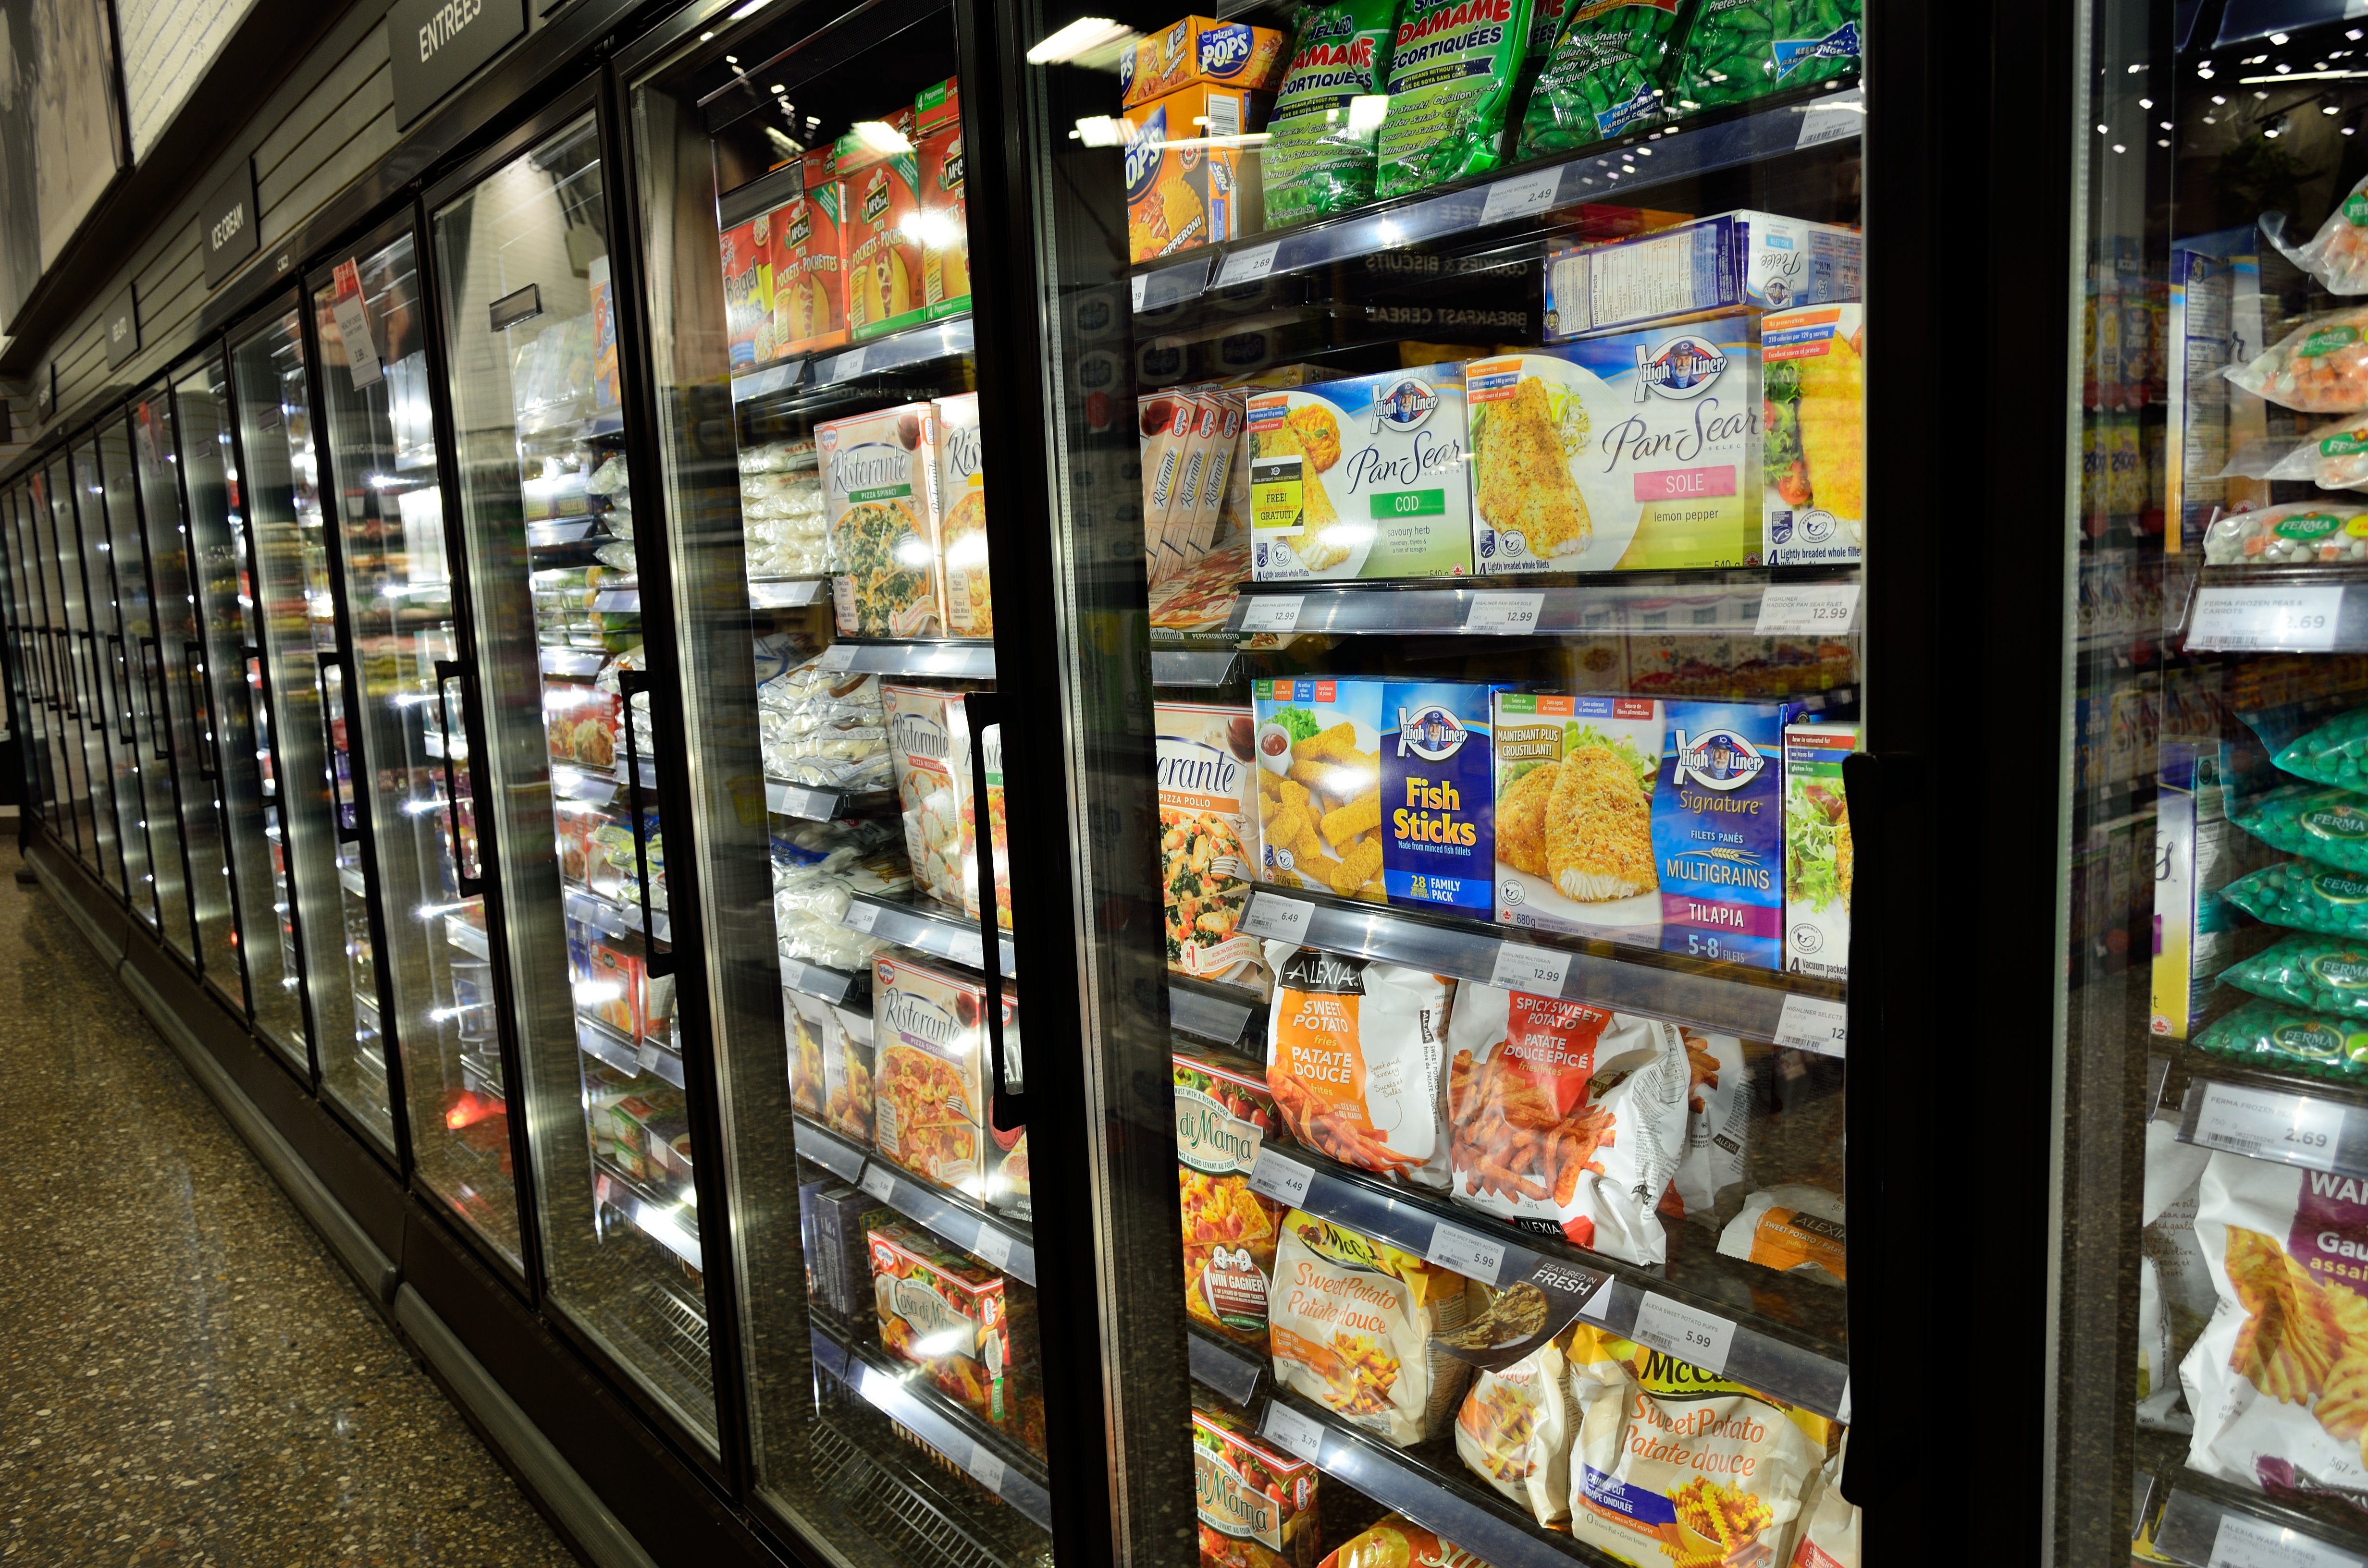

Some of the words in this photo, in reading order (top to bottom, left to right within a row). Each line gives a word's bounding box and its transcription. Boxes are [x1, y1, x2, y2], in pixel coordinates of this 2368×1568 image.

[419, 0, 482, 63] ENTREES
[1213, 28, 1233, 43] pizza
[1200, 33, 1248, 74] POPS
[1162, 49, 1186, 82] PEPPERONI
[1551, 61, 1578, 75] Ready
[1403, 70, 1428, 83] SOYBEANS
[1430, 65, 1454, 75] WITHOUT
[1612, 107, 1628, 118] KEEP
[1602, 115, 1629, 131] GARDER
[1491, 189, 1513, 197] EDAMAME
[1514, 183, 1538, 191] SOYBEANS
[1528, 189, 1552, 202] 2.49
[867, 194, 888, 217] McCain
[873, 219, 885, 233] PIZZA
[796, 247, 806, 257] PIZZA
[852, 237, 877, 268] POCKETS
[777, 262, 799, 289] POCKETS
[802, 254, 837, 272] POCHETTES
[1253, 258, 1270, 269] 2.69
[725, 256, 758, 303] Bagel
[934, 301, 952, 314] Pepperoni
[1776, 317, 1804, 327] preservatives
[1814, 330, 1828, 339] serving
[1805, 347, 1820, 355] protein
[1641, 361, 1670, 385] High
[1692, 355, 1725, 375] Liner
[1376, 397, 1397, 417] High
[1413, 395, 1436, 412] Liner
[1602, 397, 1759, 474] Pan-Sear
[827, 445, 906, 493] Ristorante
[1347, 431, 1463, 494] Pan-Sear
[1666, 474, 1704, 493] SOLE
[877, 489, 897, 498] SPINACI
[1266, 493, 1287, 503] FREE!
[1395, 496, 1419, 512] COD
[1261, 510, 1295, 520] GRATUIT!
[1654, 510, 1681, 523] lemon
[1686, 510, 1719, 523] pepper
[1387, 527, 1412, 537] savoury
[1414, 526, 1430, 536] herb
[2280, 520, 2331, 534] FERMA
[1801, 548, 1825, 559] breaded
[1827, 547, 1846, 558] whole
[1275, 612, 1294, 621] 12.99
[1507, 612, 1532, 621] 12.99
[1813, 608, 1847, 618] 12.99
[892, 712, 949, 759] Ristorante
[1403, 724, 1424, 741] High
[1441, 724, 1465, 743] Liner
[1498, 730, 1540, 742] MAINTENANT
[1541, 729, 1558, 742] PLUS
[1503, 745, 1552, 757] CROUSTILLANT!
[1681, 748, 1709, 769] High
[1729, 750, 1762, 771] Liner
[1159, 794, 1182, 805] PIZZA
[1184, 796, 1211, 808] POLLO
[1406, 777, 1460, 810] Fish
[1679, 790, 1759, 815] Signature
[1394, 808, 1476, 846] Sticks
[2312, 812, 2366, 831] FERMA
[1690, 829, 1716, 840] FILETS
[1718, 831, 1743, 844] PANÉS
[1398, 840, 1411, 849] Made
[1412, 842, 1423, 850] from
[1425, 844, 1443, 853] minced
[1444, 845, 1454, 855] fish
[1455, 846, 1471, 856] fillets
[1411, 875, 1426, 887] 28
[1666, 859, 1770, 890] MULTIGRAINS
[1431, 878, 1460, 892] FAMILY
[1432, 890, 1453, 903] PACK
[863, 915, 873, 923] 5.99
[1281, 912, 1298, 922] 6.49
[1689, 903, 1745, 928] TILAPIA
[1688, 935, 1719, 958] 5-8
[1723, 949, 1745, 964] FILETS
[1524, 956, 1551, 964] MULTIGRAIN
[1285, 959, 1356, 985] ALEXIA
[1534, 969, 1559, 981] 12.99
[1826, 964, 1847, 975] packed
[1303, 1000, 1341, 1017] SWEET
[1517, 997, 1552, 1012] SPICY
[1550, 1001, 1603, 1023] SWEET
[1787, 1005, 1815, 1017] HIGHLINER
[1815, 1012, 1843, 1020] SELECTS
[883, 987, 960, 1048] Ristorante
[1293, 1016, 1348, 1033] POTATO
[1528, 1013, 1577, 1029] POTATO
[910, 1037, 925, 1048] PIZZA
[1314, 1035, 1337, 1047] fries
[1525, 1034, 1566, 1050] PATATE
[2284, 1029, 2334, 1048] FERMA
[1292, 1046, 1352, 1068] PATATE
[1504, 1045, 1544, 1061] DOUCE
[1293, 1062, 1351, 1084] DOUCE
[1310, 1083, 1333, 1096] frites
[2210, 1095, 2238, 1108] FERMA
[2240, 1101, 2274, 1116] FROZEN
[2284, 1127, 2328, 1148] 2.69
[879, 1181, 888, 1191] 5.99
[1285, 1179, 1303, 1191] 4.49
[1764, 1221, 1789, 1235] SWEET
[1788, 1229, 1816, 1244] POTATO
[1474, 1254, 1494, 1267] 5.99
[1542, 1262, 1586, 1281] FEATURED
[1586, 1276, 1597, 1284] IN
[1210, 1273, 1227, 1287] WIN
[1229, 1275, 1264, 1293] GAGNER
[1532, 1269, 1591, 1296] FRESH
[893, 1280, 918, 1316] Casa
[1645, 1302, 1663, 1311] ALEXIA
[1663, 1308, 1681, 1318] SWEET
[1702, 1323, 1718, 1333] PUFFS
[1685, 1330, 1711, 1348] 5.99
[1629, 1393, 1697, 1436] Sweet
[1698, 1409, 1765, 1444] Potato
[1301, 1434, 1317, 1448] 3.79
[1622, 1424, 1691, 1466] Patate
[1691, 1450, 1756, 1477] douce
[1586, 1472, 1611, 1490] CRINKLE
[1612, 1482, 1626, 1496] CUT
[1585, 1486, 1603, 1503] COUPE
[2224, 1523, 2253, 1538] ALEXIA
[2292, 1548, 2315, 1561] FRIES
